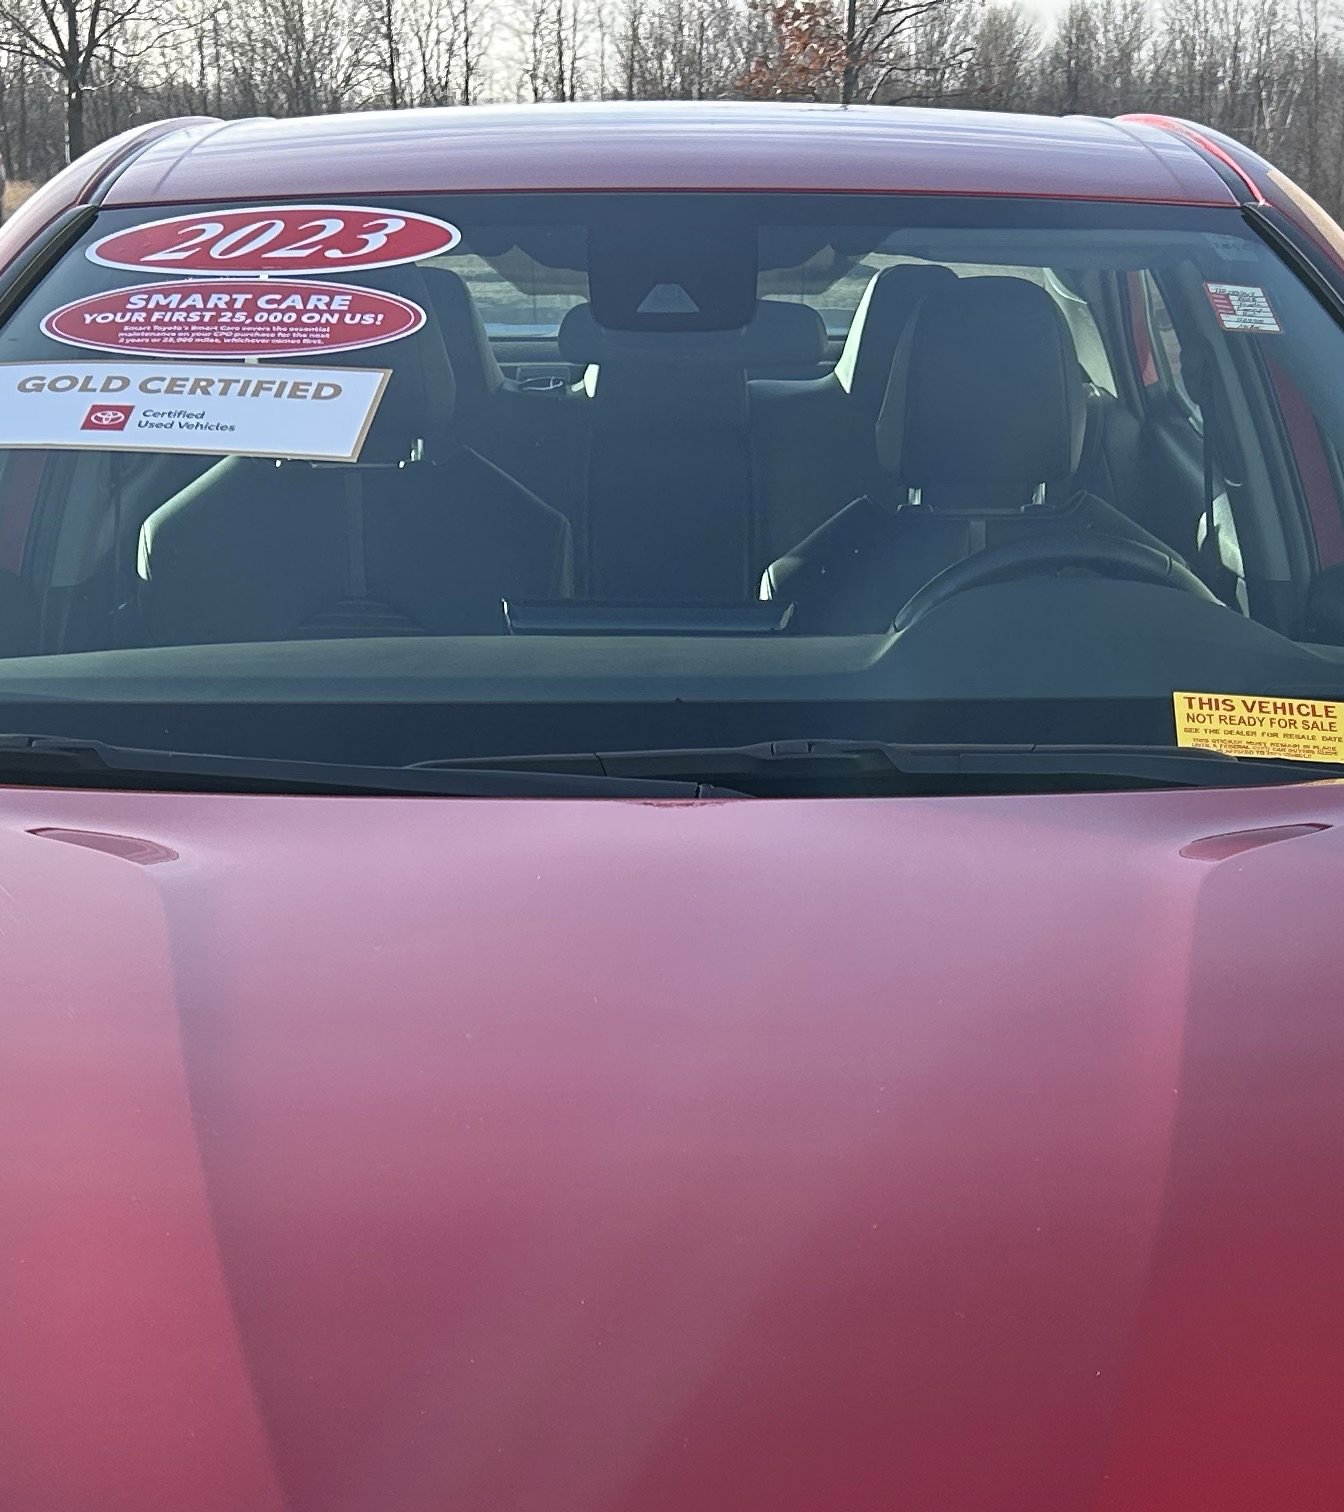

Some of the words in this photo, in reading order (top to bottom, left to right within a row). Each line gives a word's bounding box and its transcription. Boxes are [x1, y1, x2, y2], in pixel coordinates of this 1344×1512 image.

[140, 217, 406, 262] 2023
[125, 293, 253, 310] SMART
[256, 293, 354, 311] CARE
[83, 311, 149, 324] YOUR
[150, 311, 217, 323] FIRST
[218, 312, 297, 325] 25,000
[300, 312, 344, 325] ON
[345, 313, 385, 325] US!
[16, 375, 132, 393] GOLD
[138, 376, 343, 401] CERTIFIED
[142, 408, 206, 420] Certified
[137, 419, 175, 430] Used
[177, 420, 237, 432] Vehicles
[1183, 696, 1236, 712] THIS
[1241, 699, 1338, 719] VEHICLE
[1186, 712, 1215, 725] NOT
[1218, 714, 1266, 728] READY
[1269, 717, 1298, 730] FOR
[1301, 719, 1338, 732] SALE
[1223, 729, 1257, 737] DEALER
[1321, 735, 1344, 743] DATE
